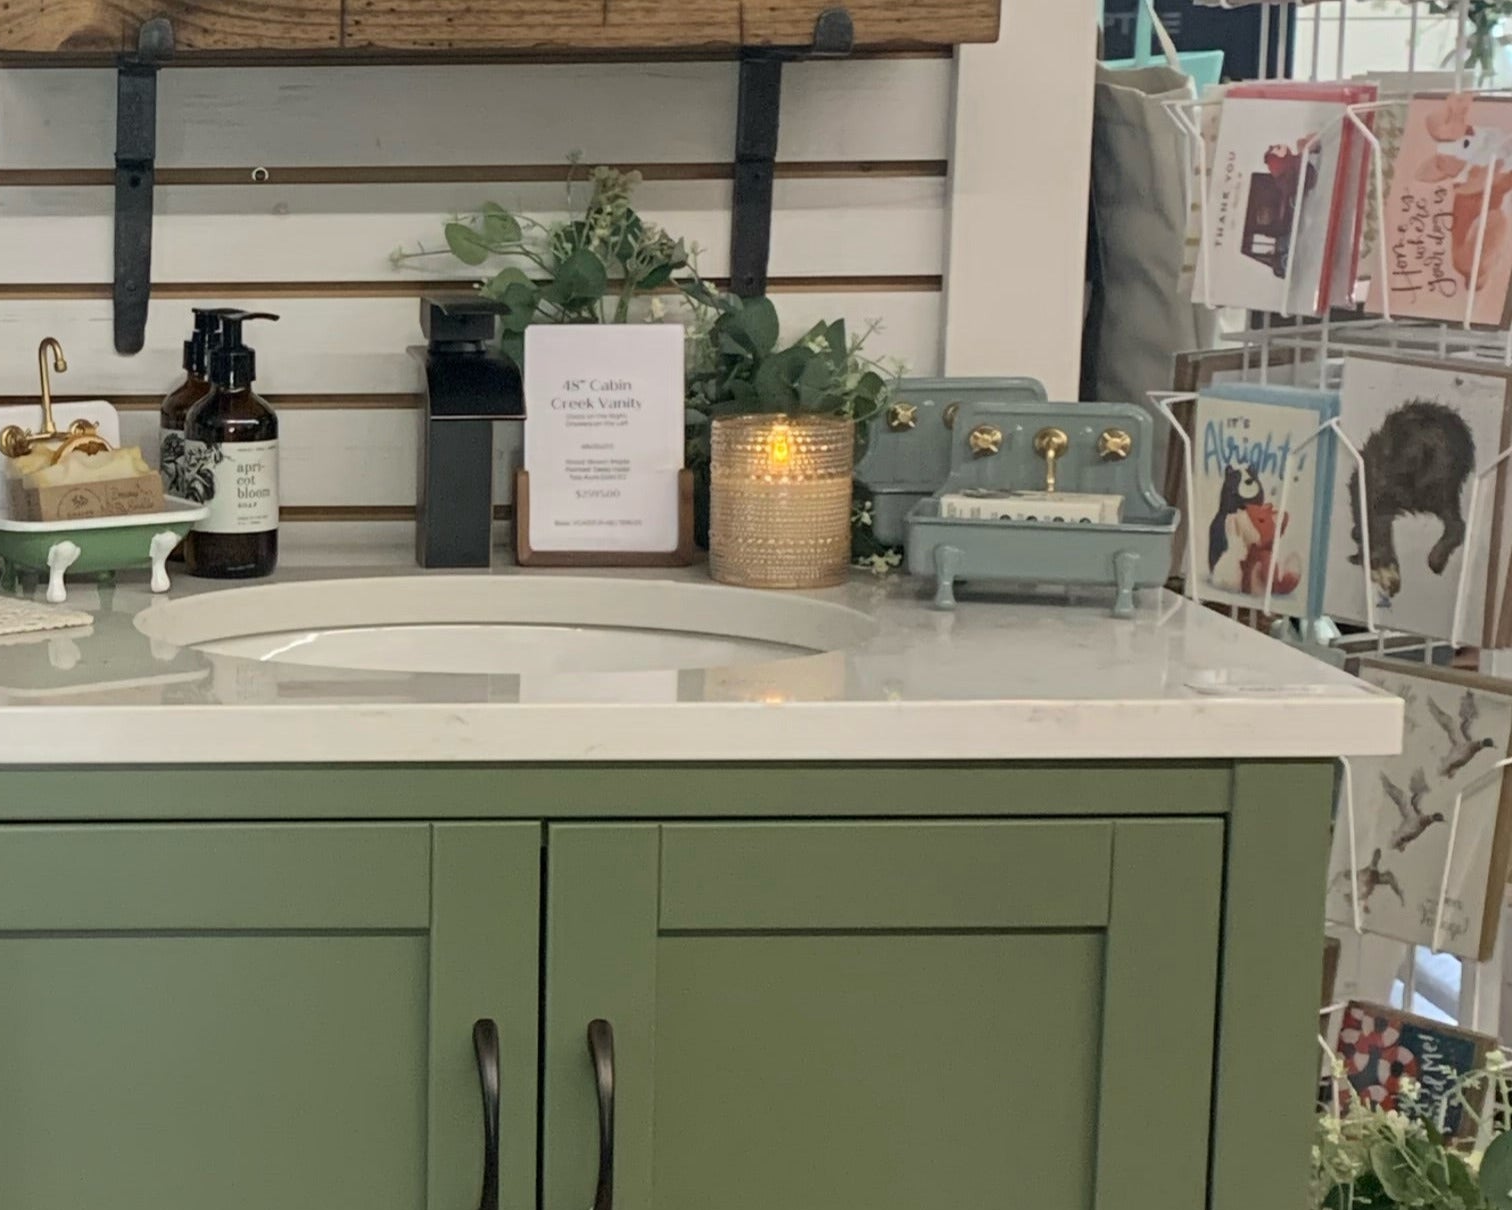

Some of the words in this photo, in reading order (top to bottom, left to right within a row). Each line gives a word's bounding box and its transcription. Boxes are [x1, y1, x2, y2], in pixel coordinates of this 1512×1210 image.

[1214, 191, 1230, 246] THANK
[589, 378, 633, 392] Cabin
[551, 397, 594, 411] Creek
[598, 397, 642, 411] Vanity
[237, 475, 256, 486] cot
[237, 487, 271, 499] bloom
